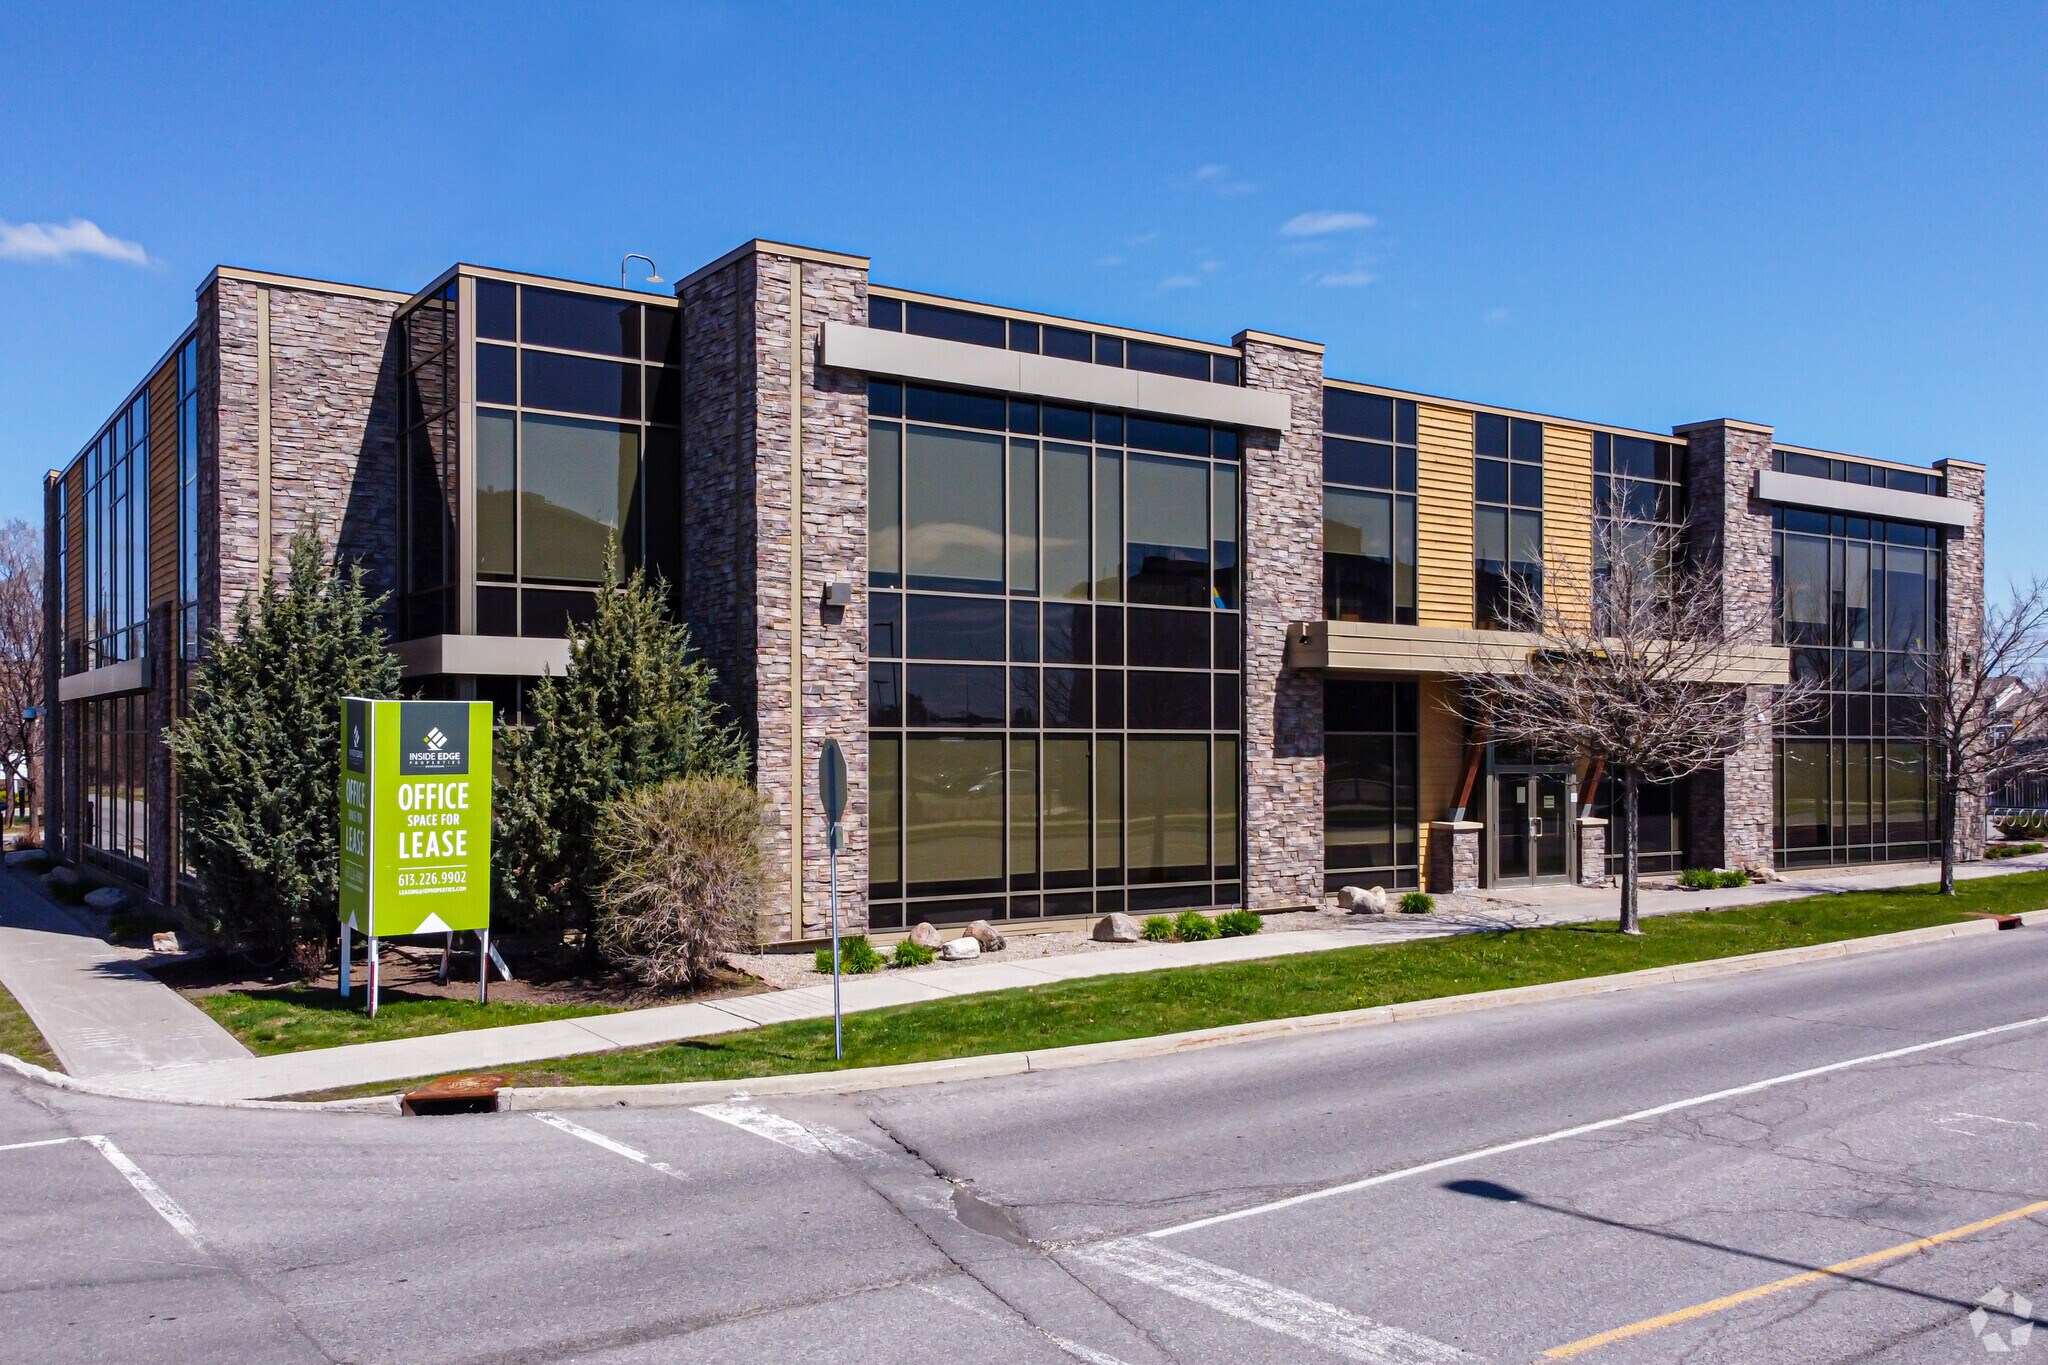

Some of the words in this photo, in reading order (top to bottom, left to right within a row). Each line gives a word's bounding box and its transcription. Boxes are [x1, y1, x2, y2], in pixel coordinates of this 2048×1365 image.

[409, 752, 436, 761] INSIDE
[437, 752, 461, 761] EDGE
[346, 778, 365, 809] OFFICE
[398, 782, 469, 811] OFFICE
[407, 814, 438, 827] SPACE
[441, 813, 460, 826] FOR
[345, 824, 365, 857] LEASE
[399, 829, 467, 859] LEASE
[398, 870, 467, 886] 613.226.9902
